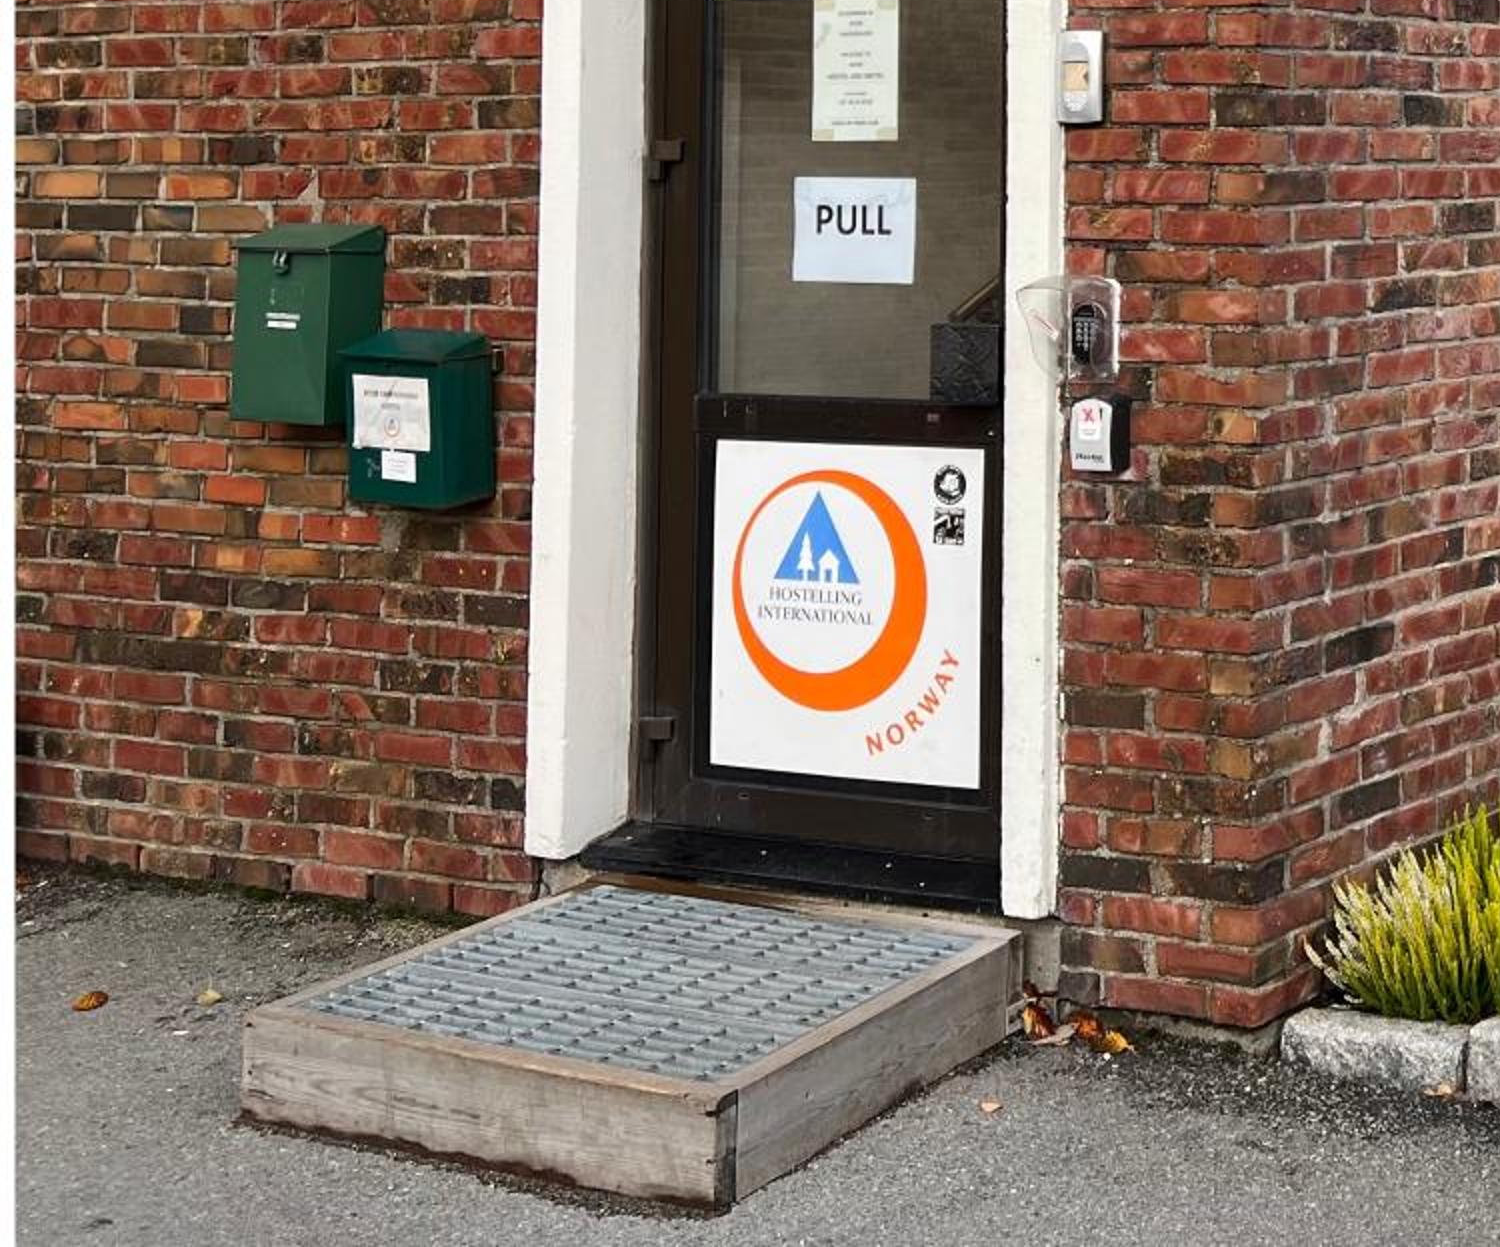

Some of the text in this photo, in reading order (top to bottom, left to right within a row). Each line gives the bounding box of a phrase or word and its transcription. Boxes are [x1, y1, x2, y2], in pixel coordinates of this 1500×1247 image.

[816, 204, 892, 235] PULL
[769, 586, 863, 606] HOSTELLING
[758, 605, 873, 626] INTERNATIONAL
[865, 649, 960, 756] NORWAY
